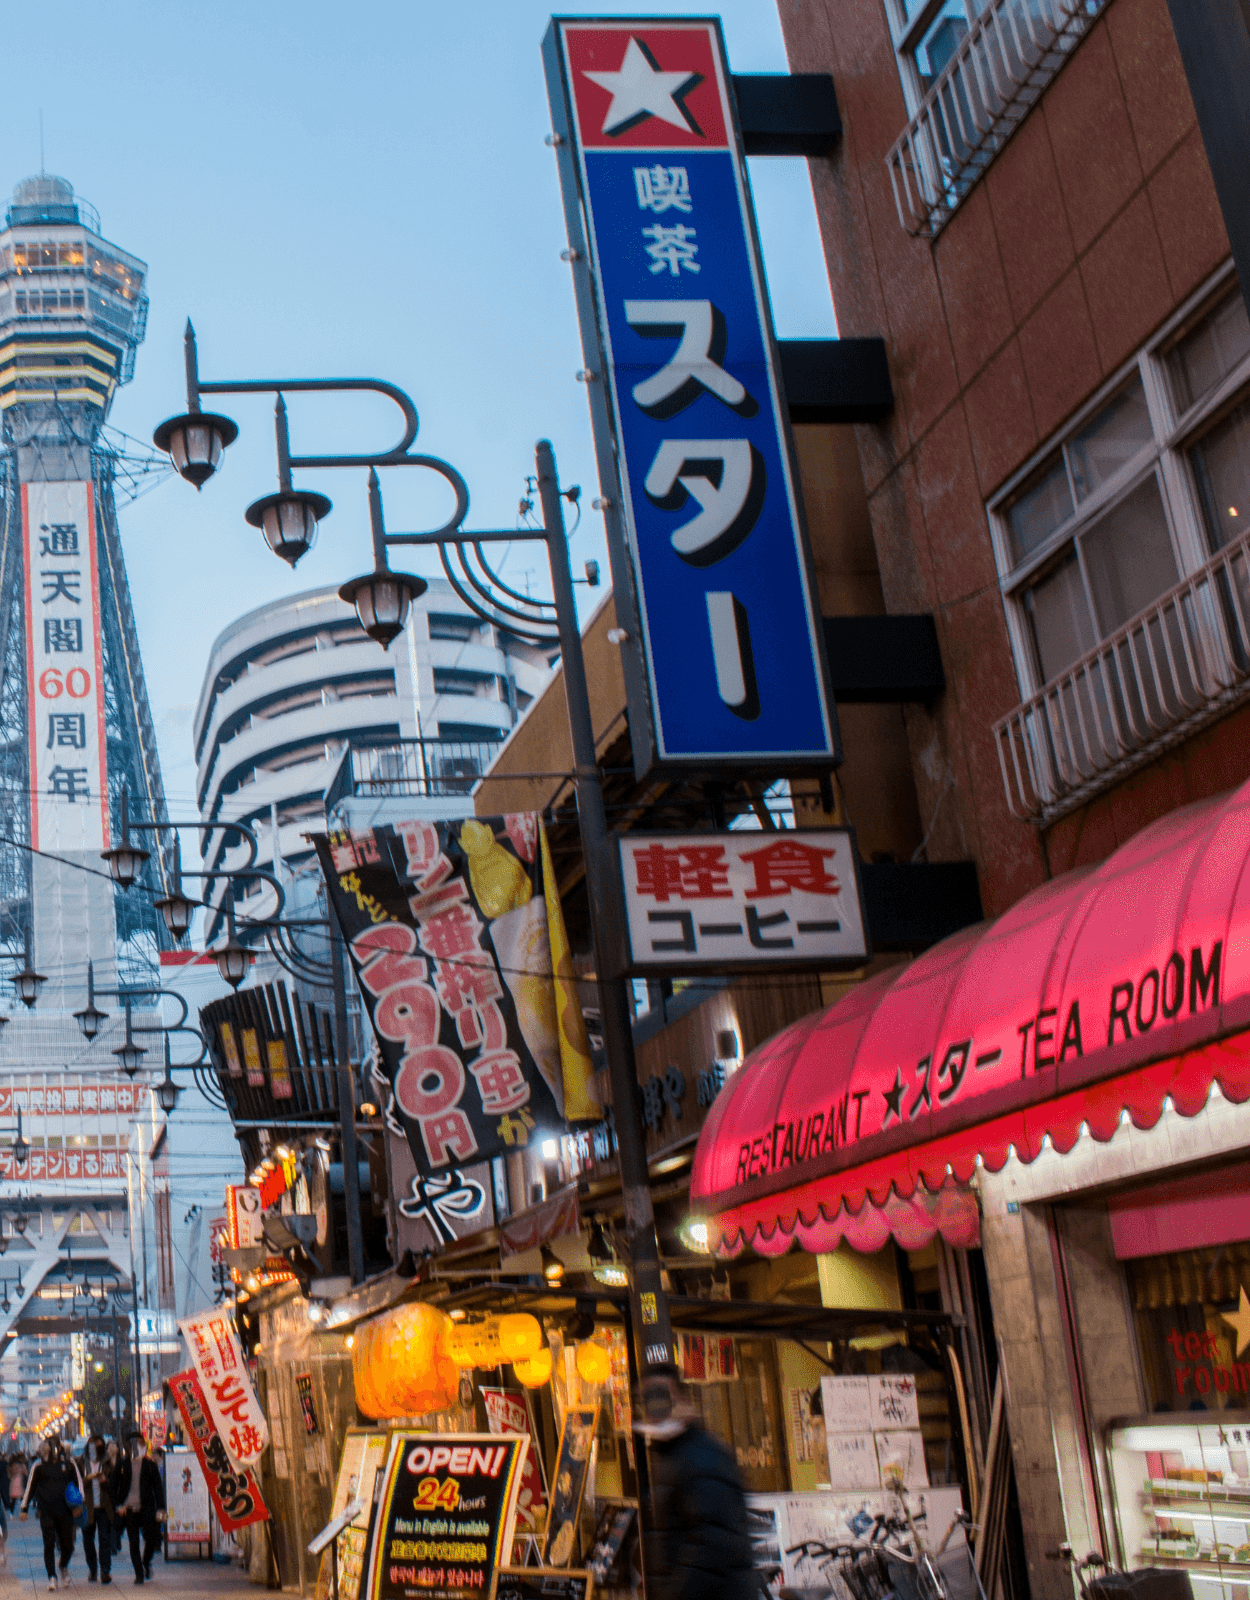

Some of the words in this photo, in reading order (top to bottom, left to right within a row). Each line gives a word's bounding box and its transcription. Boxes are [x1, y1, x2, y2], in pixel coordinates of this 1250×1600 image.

[633, 164, 700, 275] 喫茶
[624, 299, 764, 718] スター
[39, 523, 91, 805] 通天閣60周年
[632, 838, 842, 902] 軽食
[646, 904, 842, 953] コーヒー
[350, 920, 479, 1169] 290円
[736, 1090, 871, 1186] RESTAURANT
[907, 1037, 1006, 1123] スター
[1017, 1006, 1083, 1079] TEA
[1106, 940, 1223, 1047] ROOM
[1166, 1327, 1219, 1362] tea
[406, 1445, 507, 1478] OPEN!
[413, 1476, 460, 1512] 24
[458, 1495, 486, 1512] hours
[394, 1517, 414, 1533] Menu
[414, 1518, 422, 1534] in
[422, 1517, 448, 1537] English
[448, 1519, 456, 1534] is
[456, 1519, 490, 1537] available
